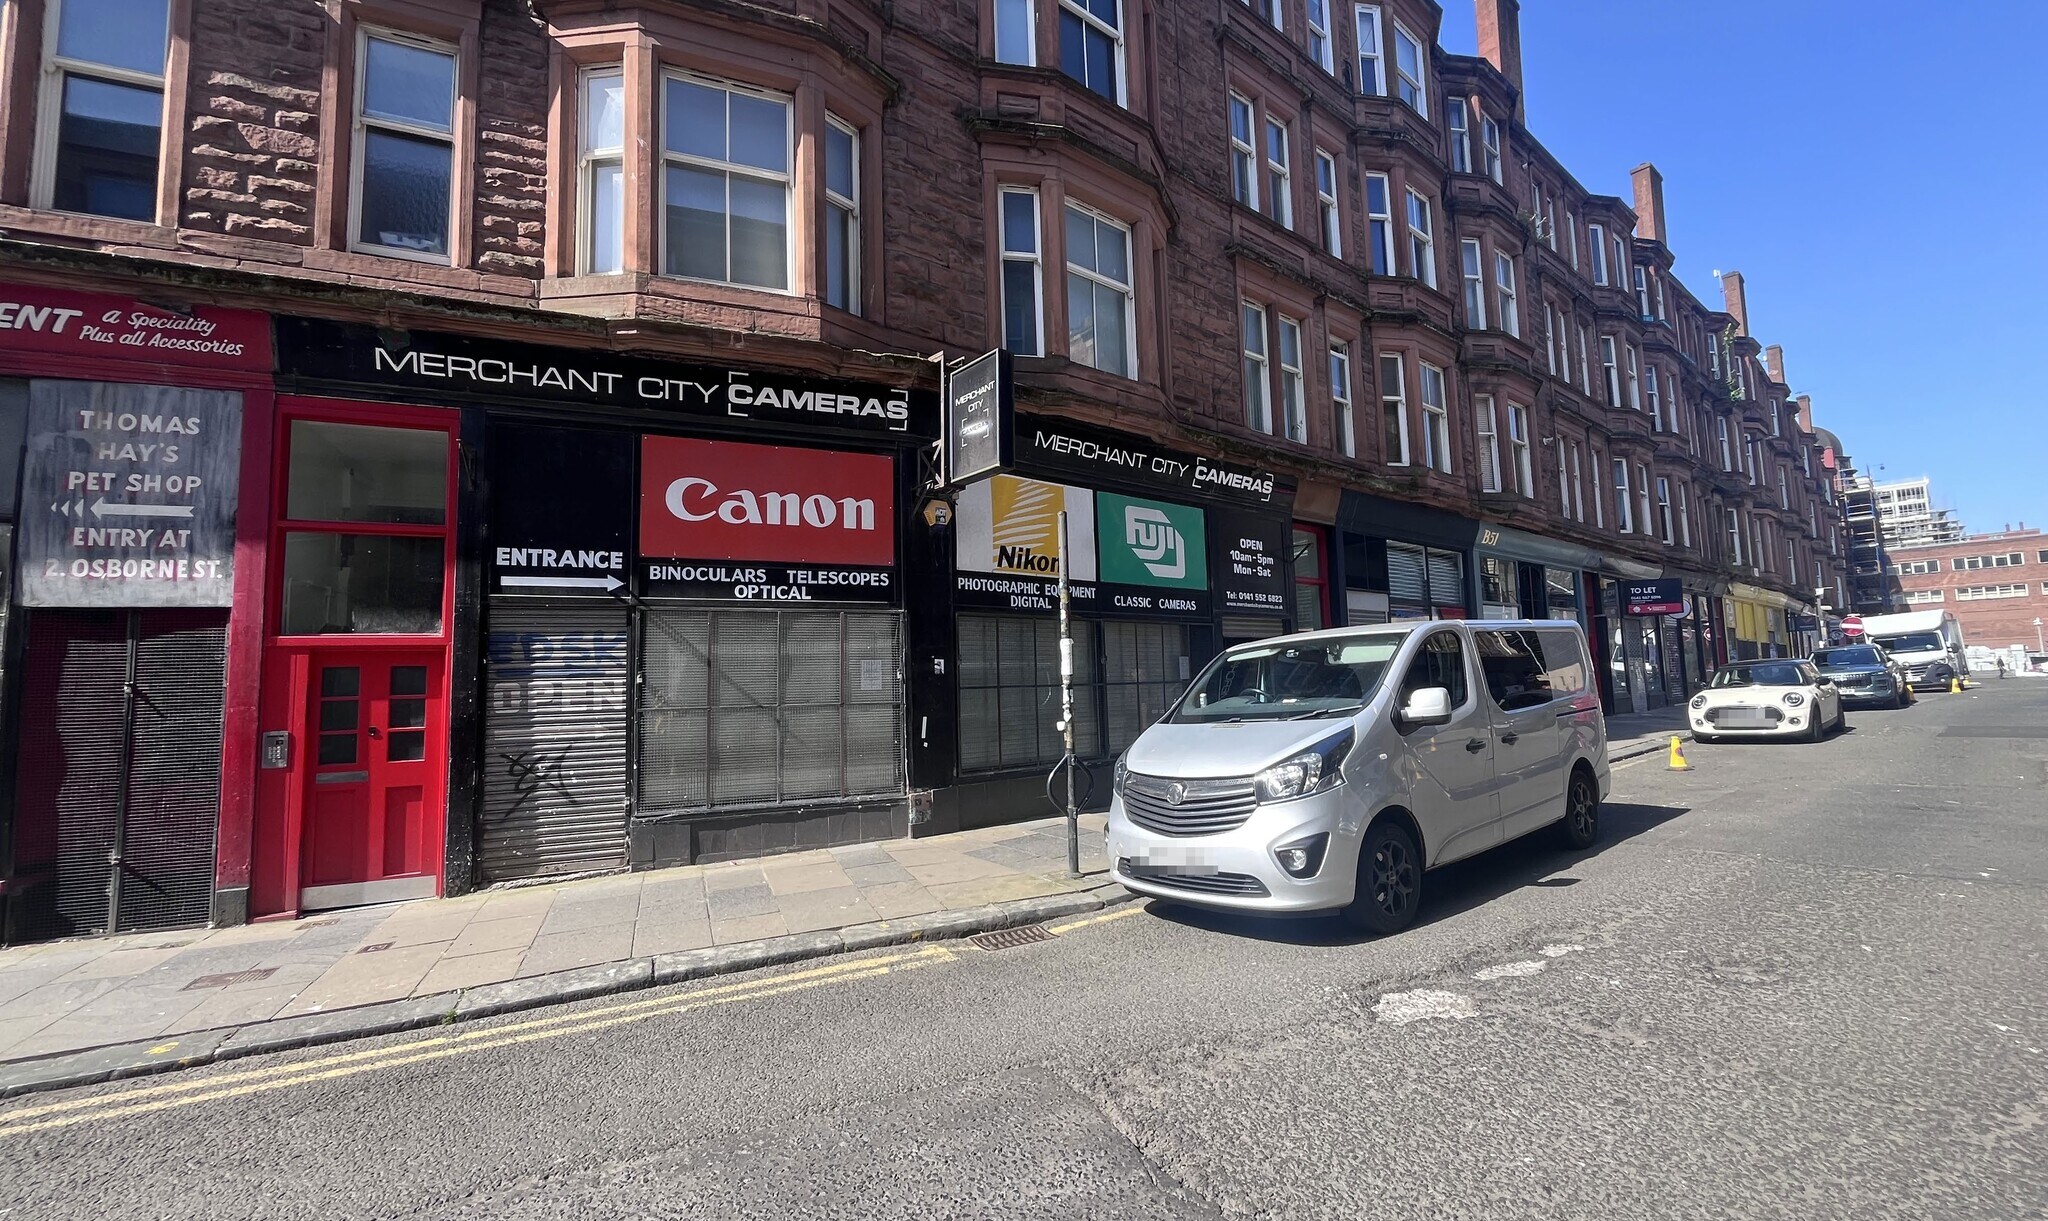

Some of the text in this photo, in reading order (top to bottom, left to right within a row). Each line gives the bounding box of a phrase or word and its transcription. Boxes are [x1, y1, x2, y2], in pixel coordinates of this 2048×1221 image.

[102, 310, 217, 337] a Speciality
[79, 325, 244, 356] Plus all Accessories
[374, 347, 909, 420] MERCHANT CITY CAMERAS
[955, 380, 996, 413] MERCHANT CITY
[80, 410, 201, 435] THOMAS
[98, 442, 179, 463] HAY'S
[1035, 431, 1273, 494] MERCHANT CITY CAMERAS
[68, 471, 202, 494] PET SHOP
[665, 477, 875, 531] Canon
[73, 527, 191, 548] ENTRY AT
[1125, 506, 1184, 578] FUJI
[1240, 538, 1263, 551] OPEN
[496, 547, 623, 569] ENTRANCE
[649, 566, 889, 587] BINOCULARS TELESCOPES
[734, 584, 812, 600] OPTICAL
[958, 578, 1096, 599] PHOTOGRAPHIC EQPMENT
[1226, 591, 1237, 599] Tel:
[1238, 592, 1254, 600] 0141
[1255, 593, 1266, 601] 552
[1643, 586, 1657, 594] LET
[1010, 595, 1052, 609] DIGITAL
[1114, 595, 1197, 611] CLASSIC CAMERAS
